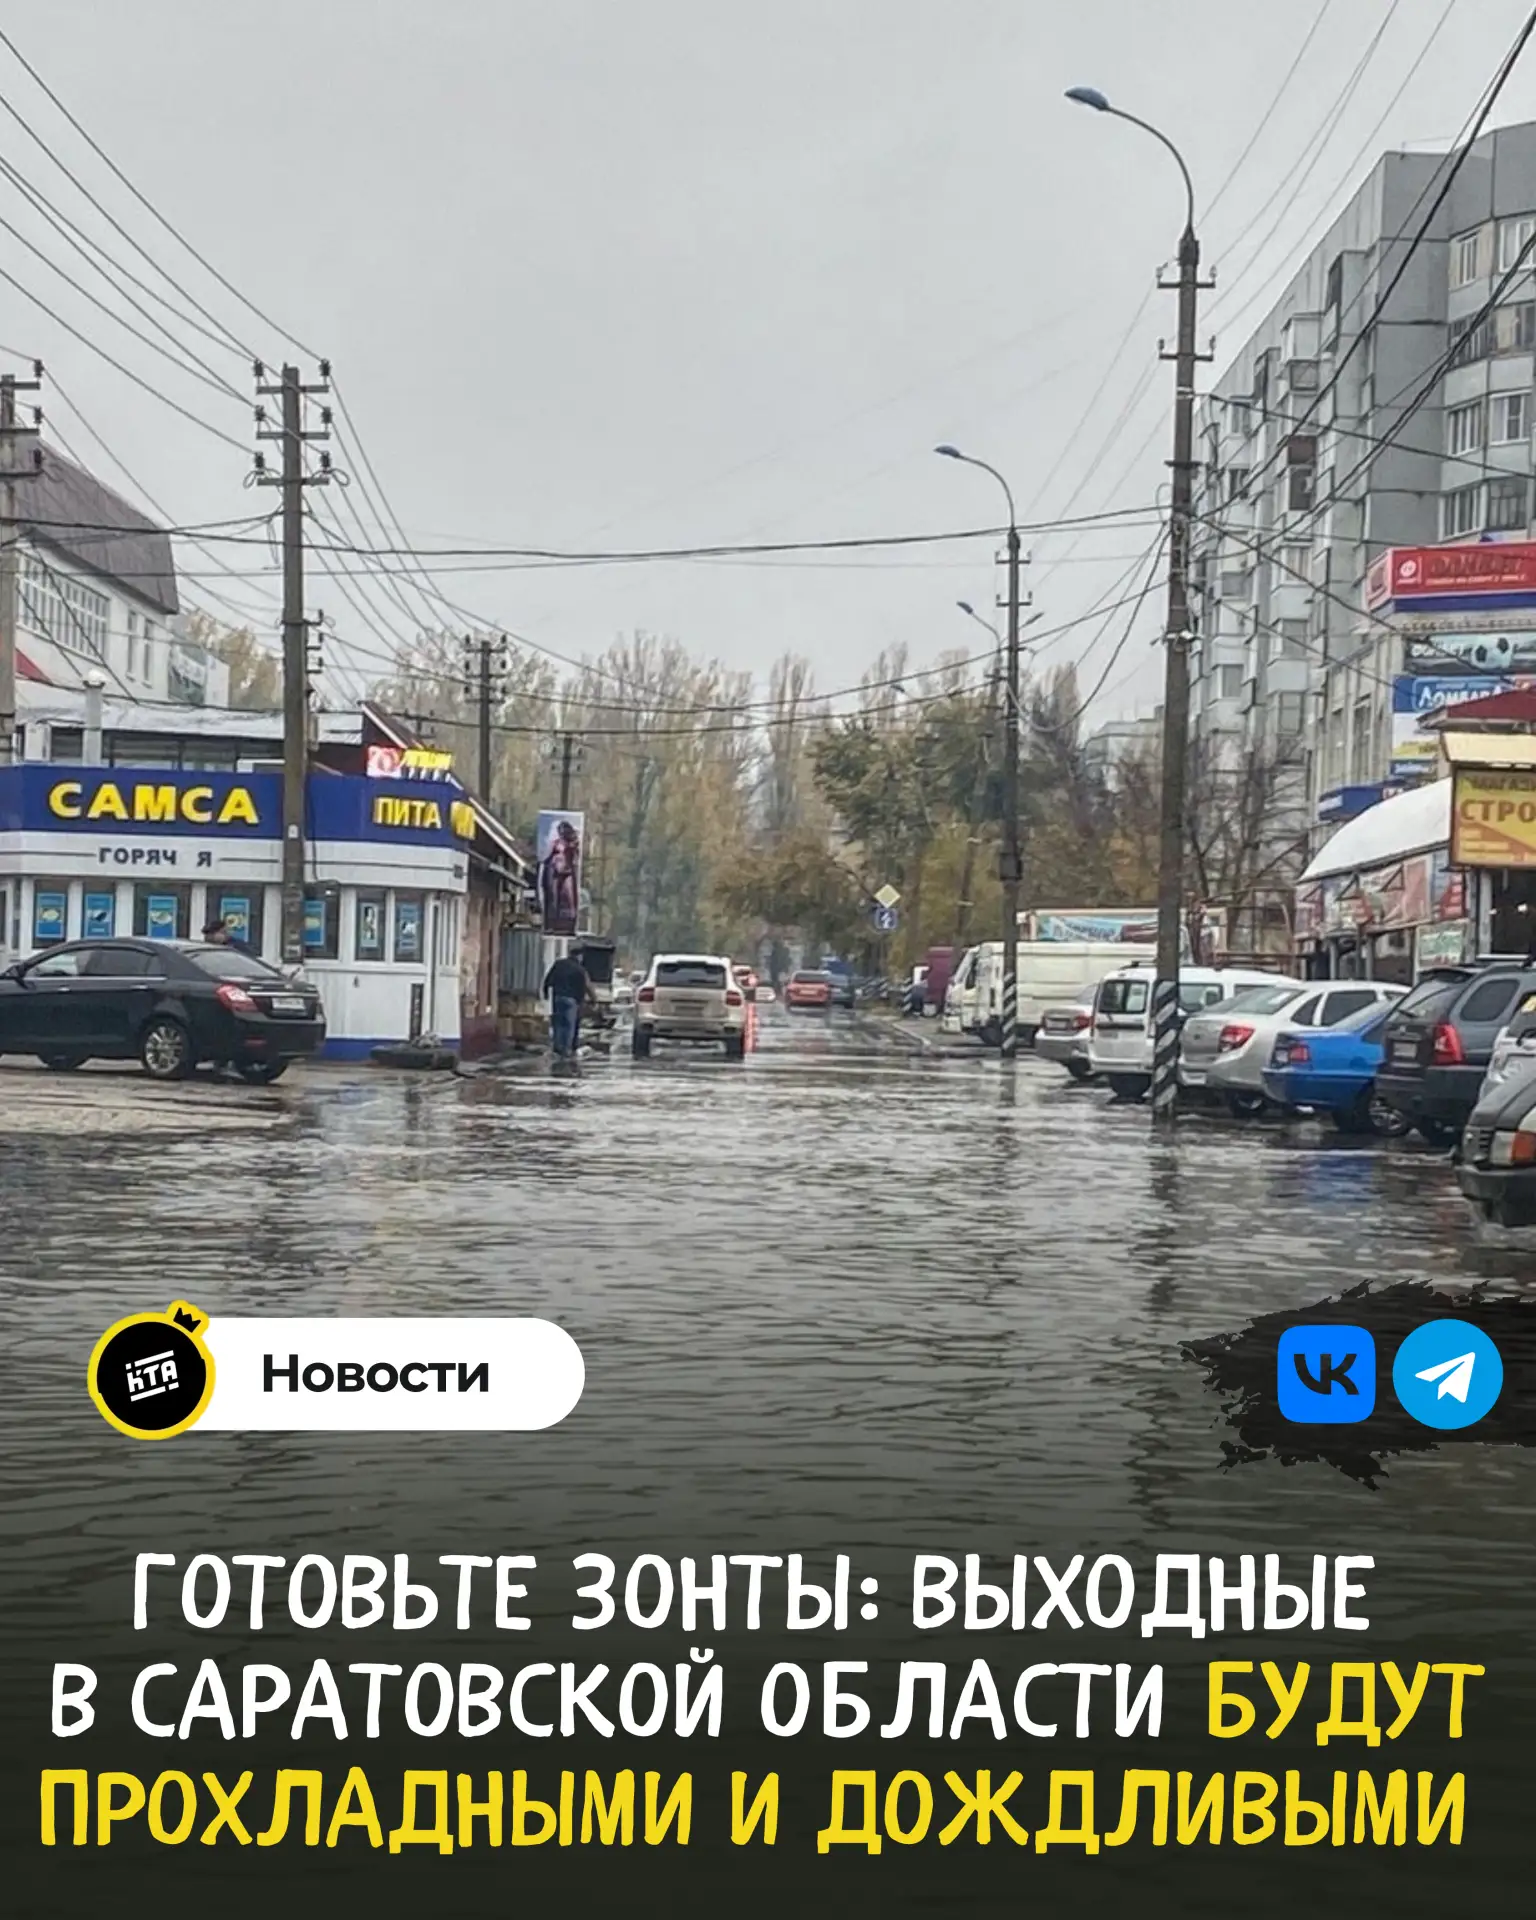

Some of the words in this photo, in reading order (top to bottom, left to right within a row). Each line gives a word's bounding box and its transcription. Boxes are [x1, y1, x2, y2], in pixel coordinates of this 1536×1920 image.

[49, 780, 260, 825] САМСА
[372, 796, 442, 830] ПИТА
[1460, 798, 1536, 823] СТРО
